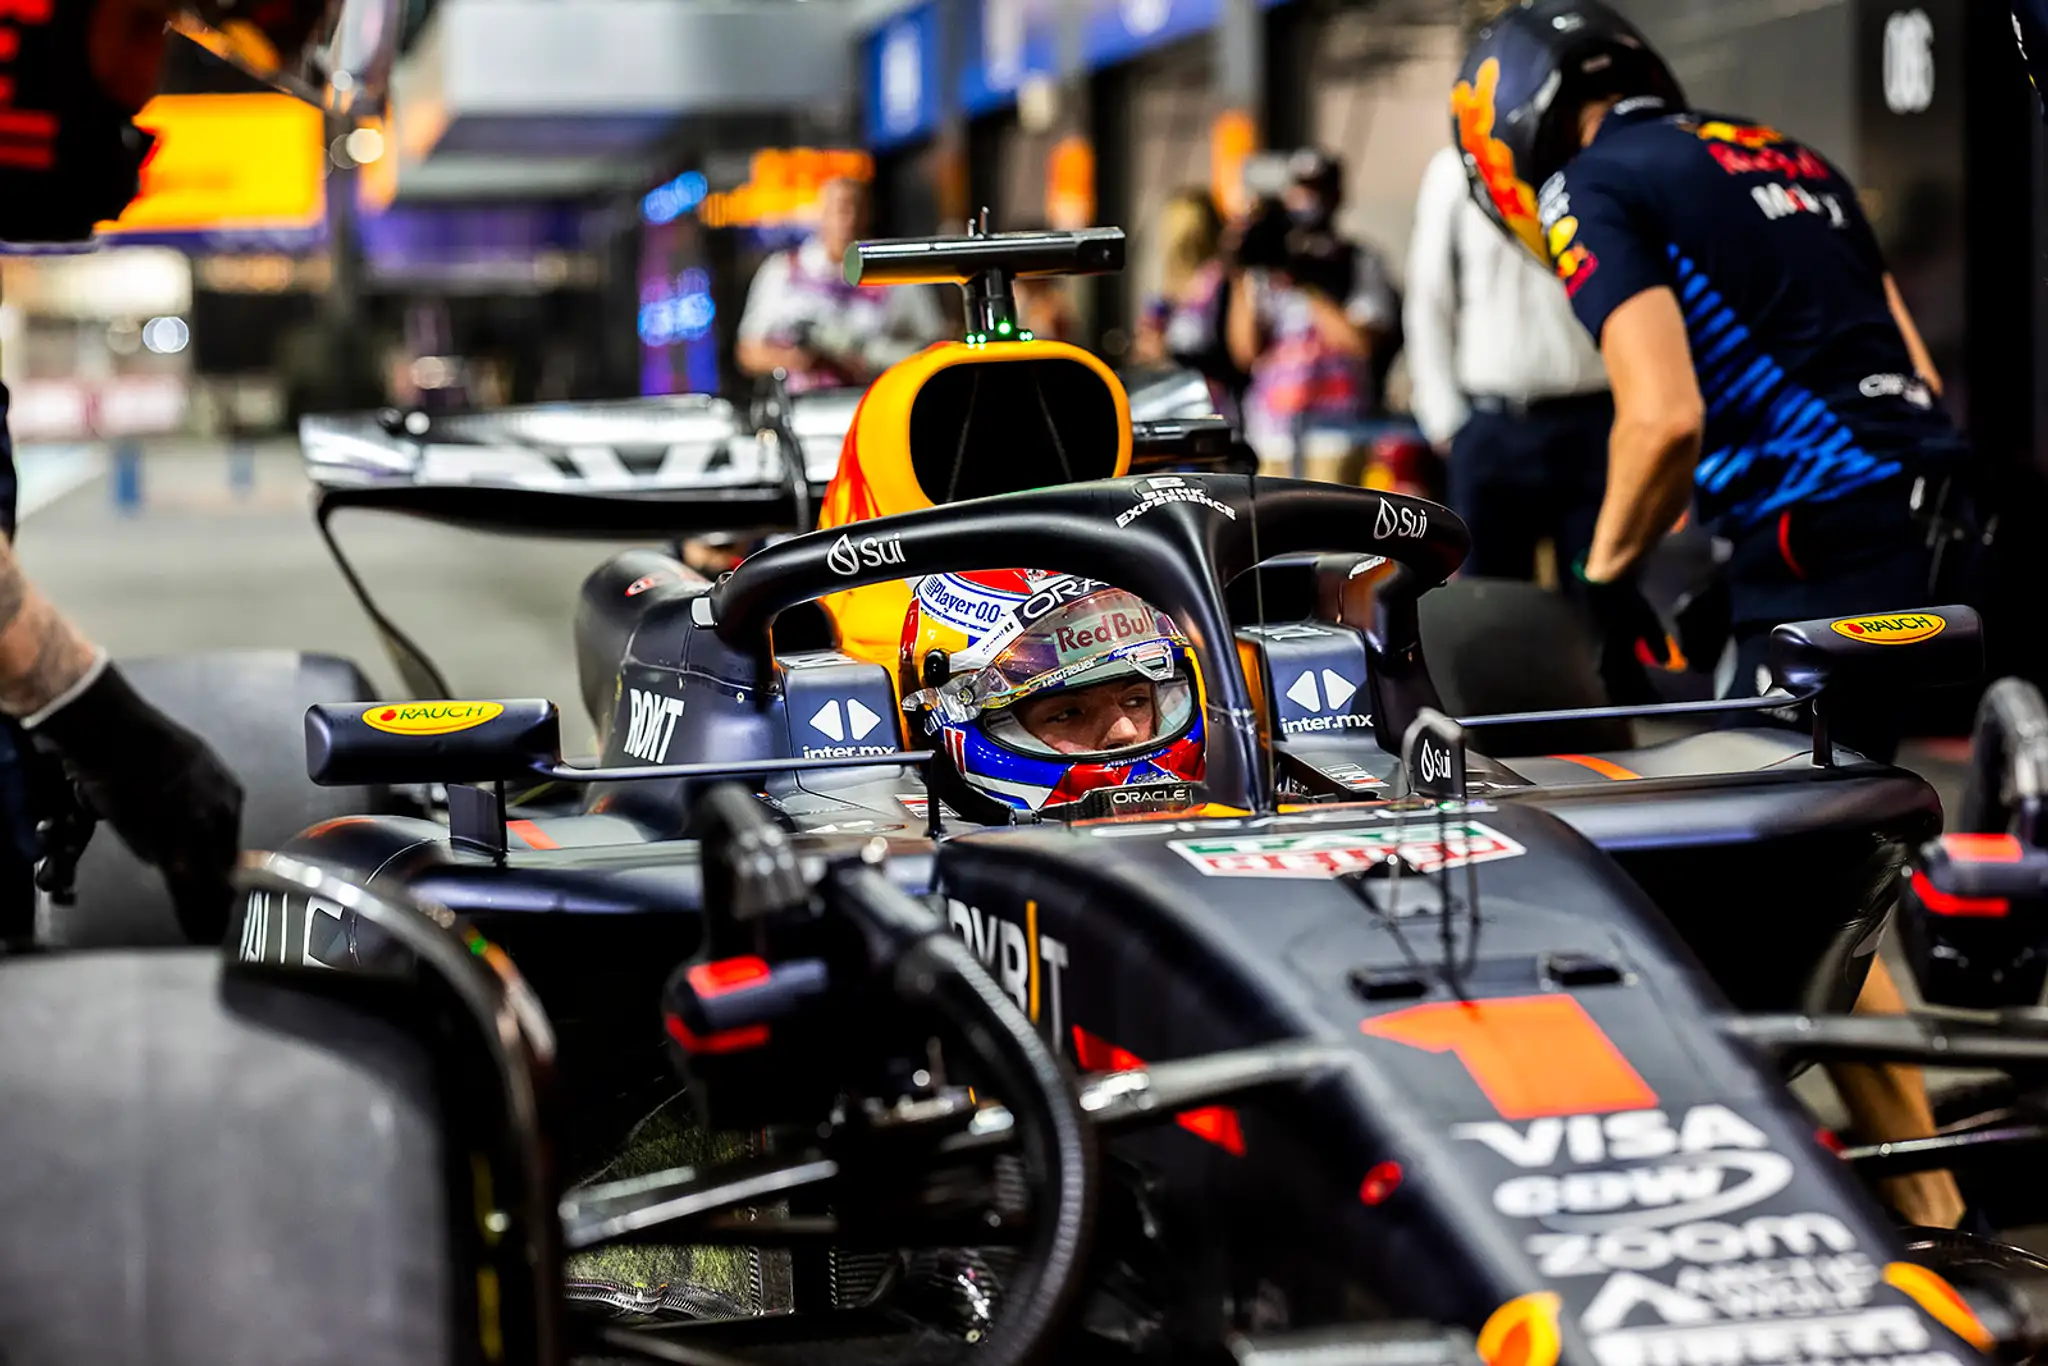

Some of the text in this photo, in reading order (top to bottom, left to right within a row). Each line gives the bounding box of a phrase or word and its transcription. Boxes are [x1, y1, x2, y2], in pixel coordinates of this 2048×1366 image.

[1141, 487, 1204, 500] BLINK
[1115, 494, 1237, 529] EXPERIENCE
[1397, 507, 1427, 539] Sui
[860, 532, 906, 566] Sui
[929, 580, 977, 615] Player
[1056, 614, 1112, 653] Red
[1862, 616, 1933, 633] RAUCH
[399, 706, 484, 720] RAUCH
[1281, 712, 1374, 734] inter.mx
[802, 745, 896, 759] inter.mx
[1434, 749, 1451, 780] Sui
[1112, 789, 1187, 804] ORACLE
[1360, 994, 1659, 1118] 1
[1451, 1104, 1769, 1167] VISA
